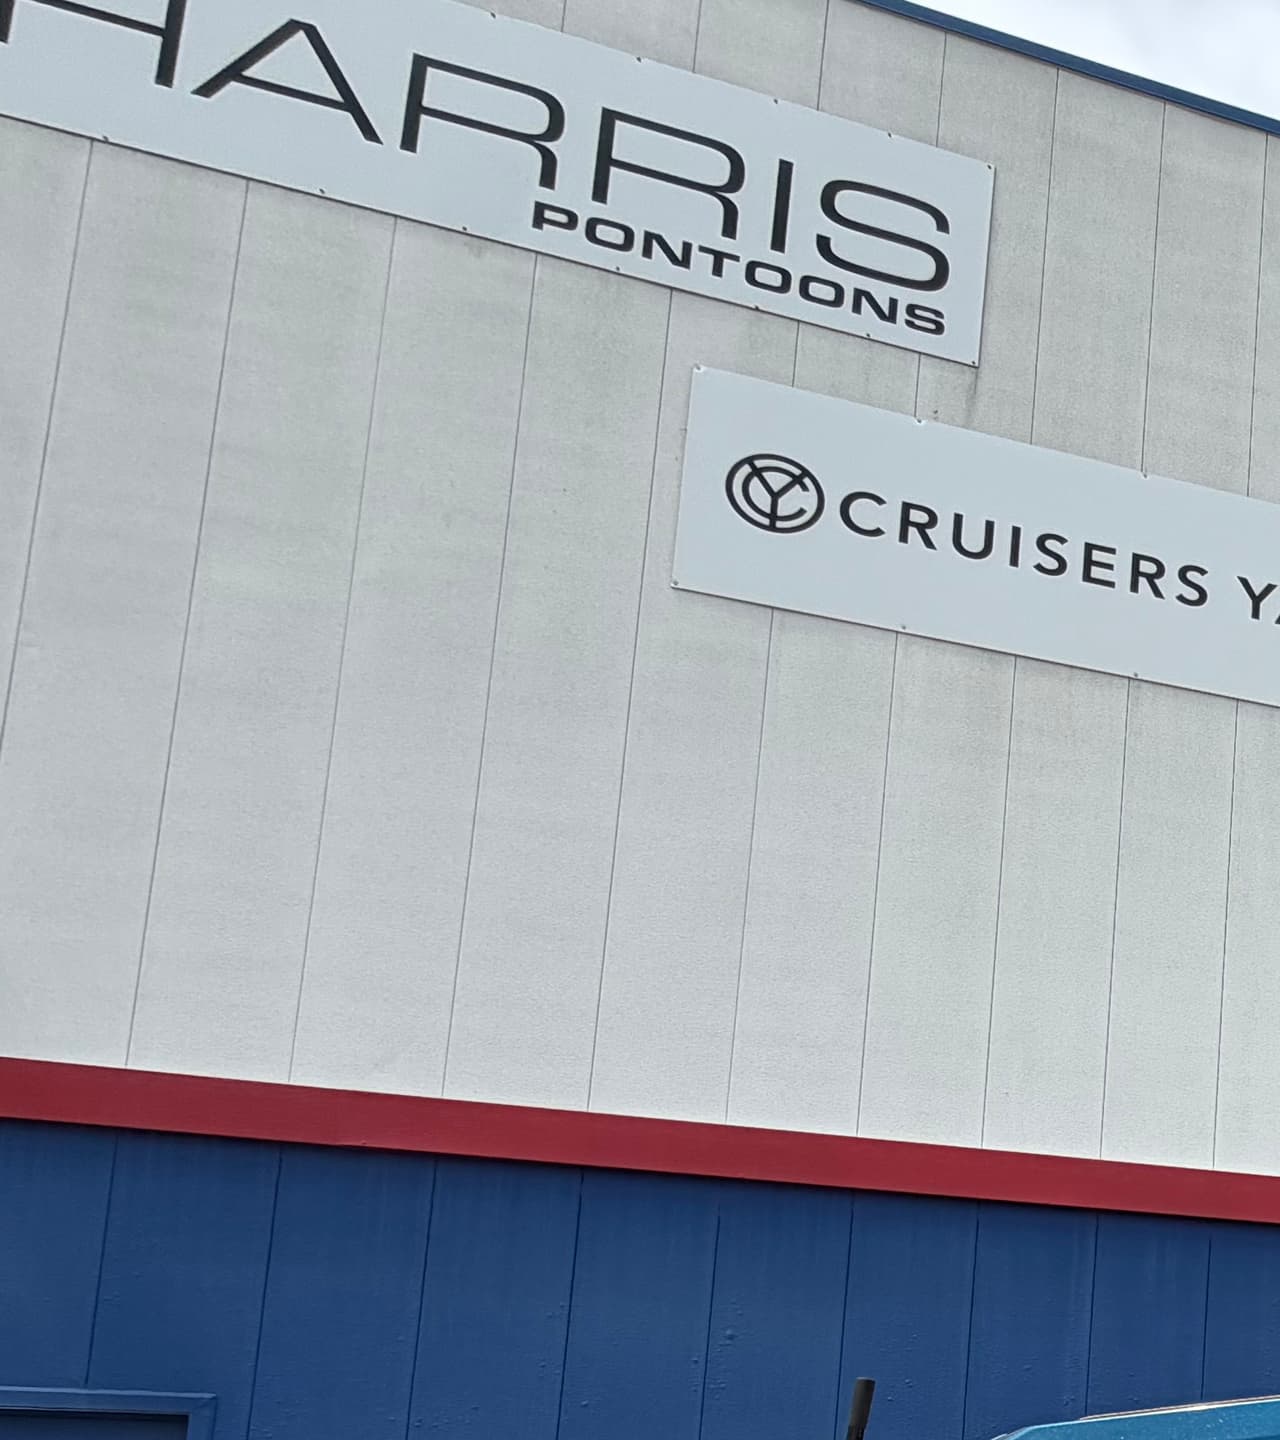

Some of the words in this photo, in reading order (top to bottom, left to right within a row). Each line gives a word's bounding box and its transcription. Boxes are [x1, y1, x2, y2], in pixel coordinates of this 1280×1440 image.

[0, 0, 950, 291] HARRIS
[531, 201, 945, 336] PONTOONS
[839, 490, 1209, 607] CRUISERS
